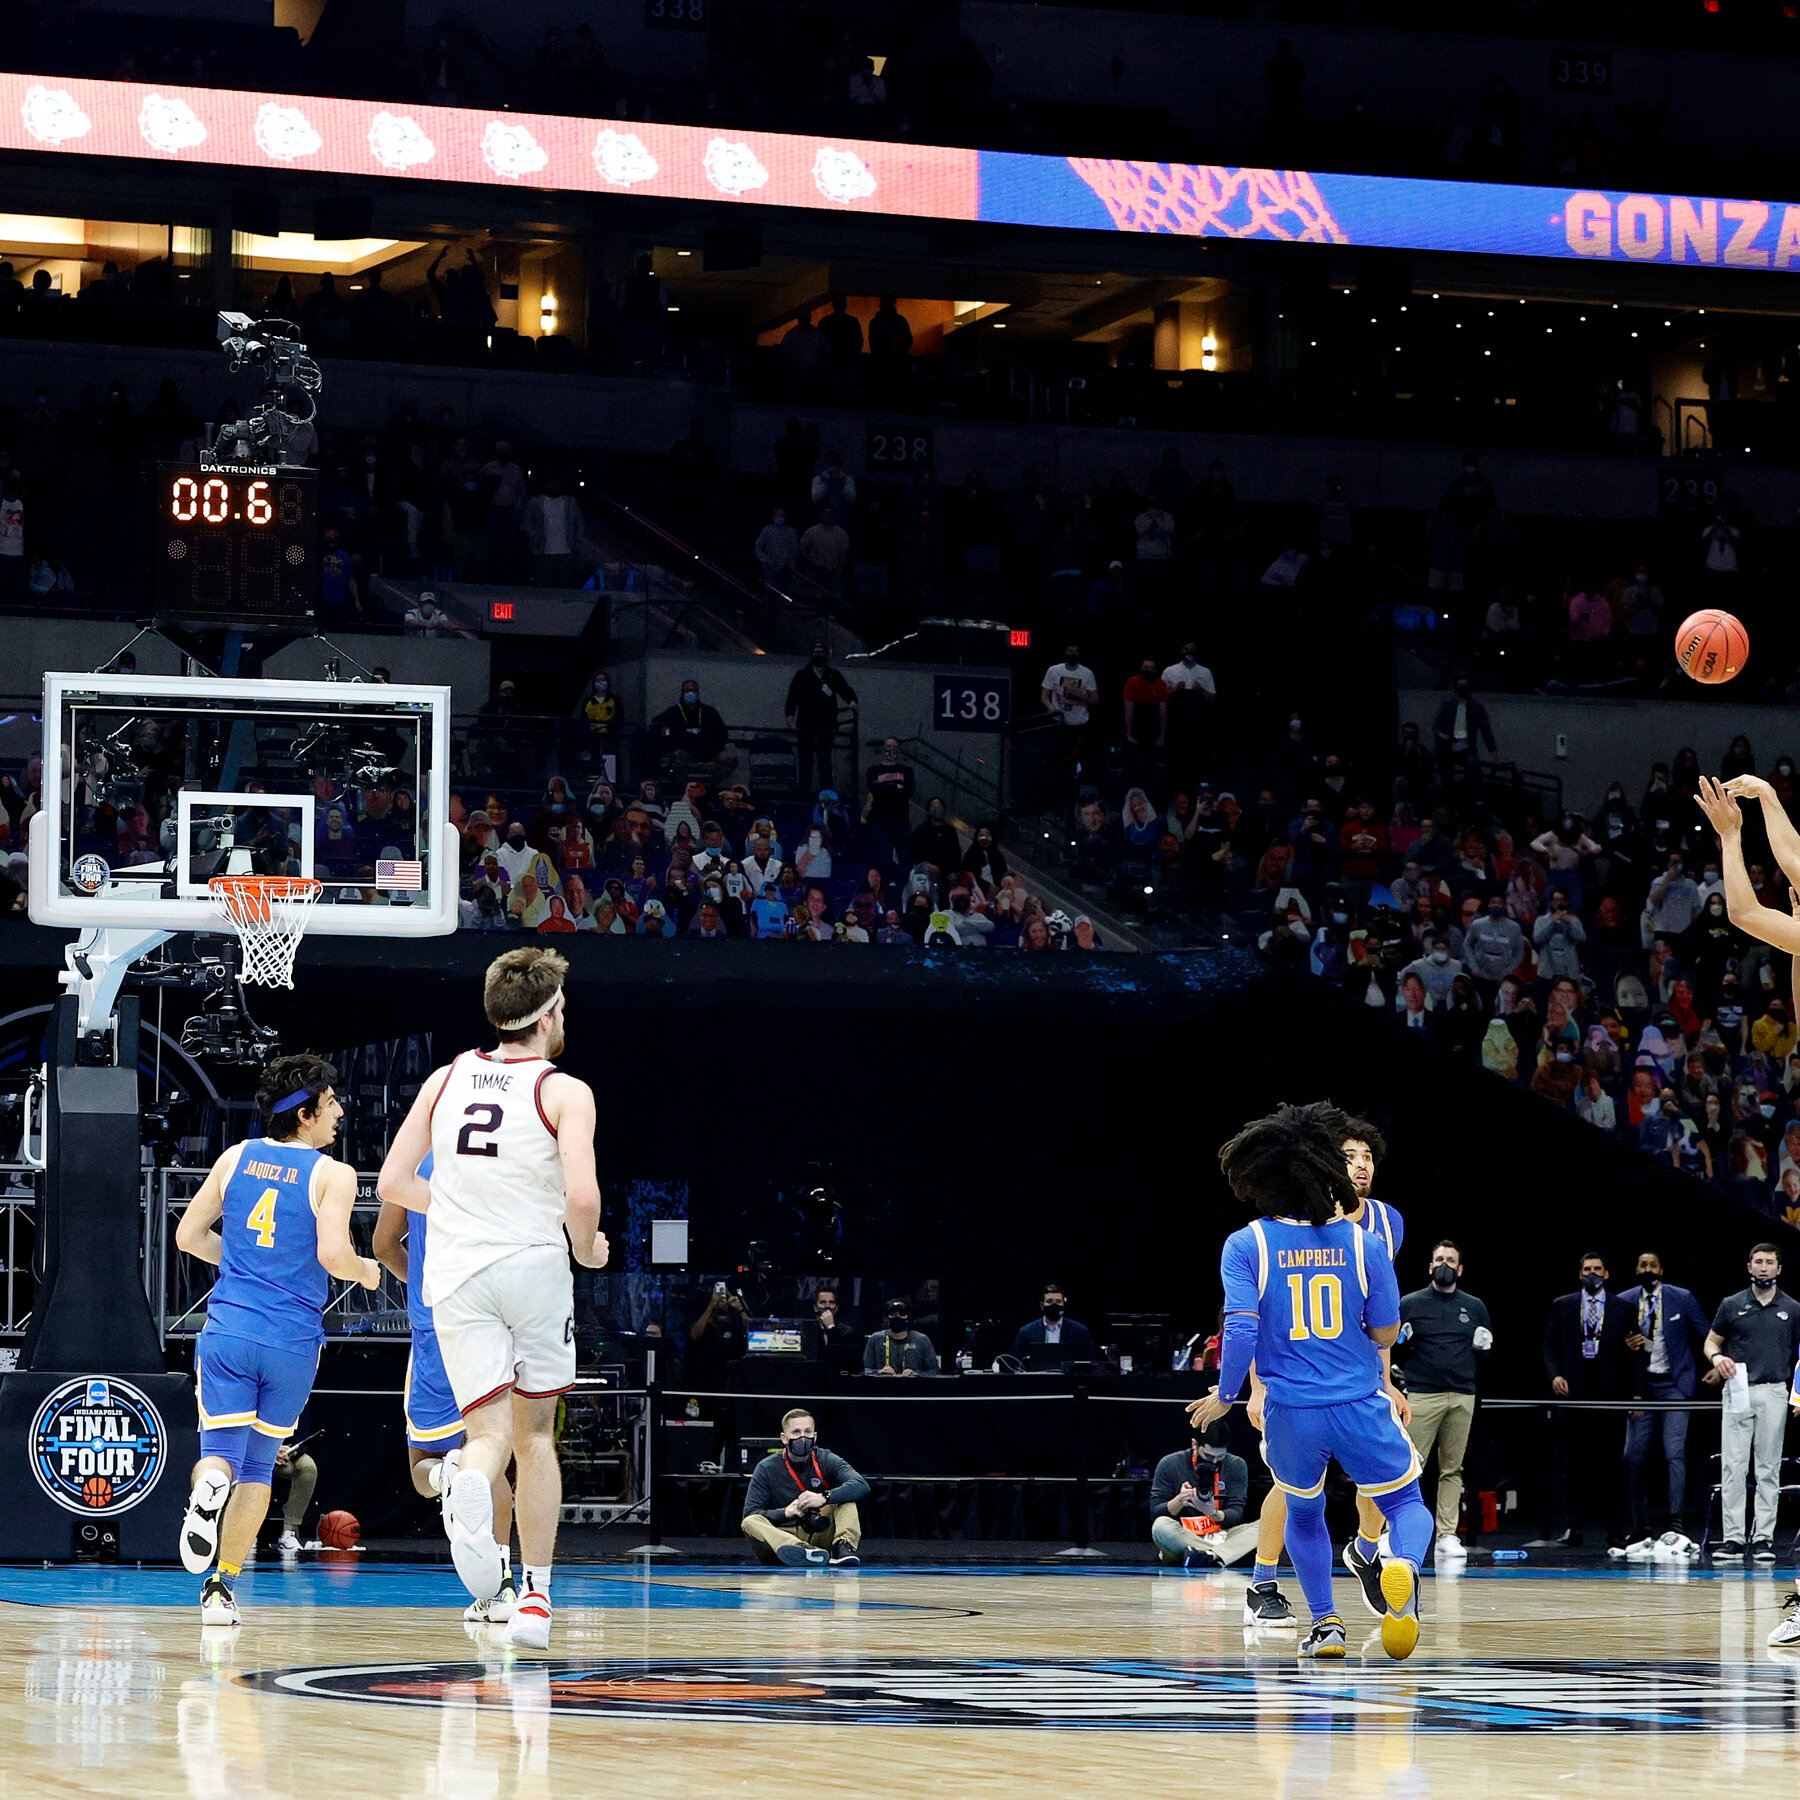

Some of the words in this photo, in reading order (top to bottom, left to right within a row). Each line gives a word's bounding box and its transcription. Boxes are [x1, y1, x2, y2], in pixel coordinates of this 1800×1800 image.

[1557, 59, 1607, 85] 339
[873, 435, 928, 462] 238
[200, 464, 277, 475] DAKTRONICS
[172, 477, 272, 525] 00.6
[494, 602, 513, 619] EXIT
[1011, 630, 1029, 646] EXIT
[941, 689, 1000, 720] 138
[80, 864, 101, 872] FINAL
[80, 873, 102, 882] FOUR
[471, 1073, 514, 1092] TIMME
[456, 1103, 504, 1157] 2
[243, 1160, 283, 1180] JAQUEZ
[283, 1167, 299, 1185] JR.
[246, 1187, 279, 1249] 4
[1277, 1248, 1347, 1268] CAMPBELL
[1287, 1273, 1344, 1341] 10
[59, 1416, 137, 1441] FINAL
[60, 1448, 135, 1476] FOUR
[74, 1476, 84, 1484] 20
